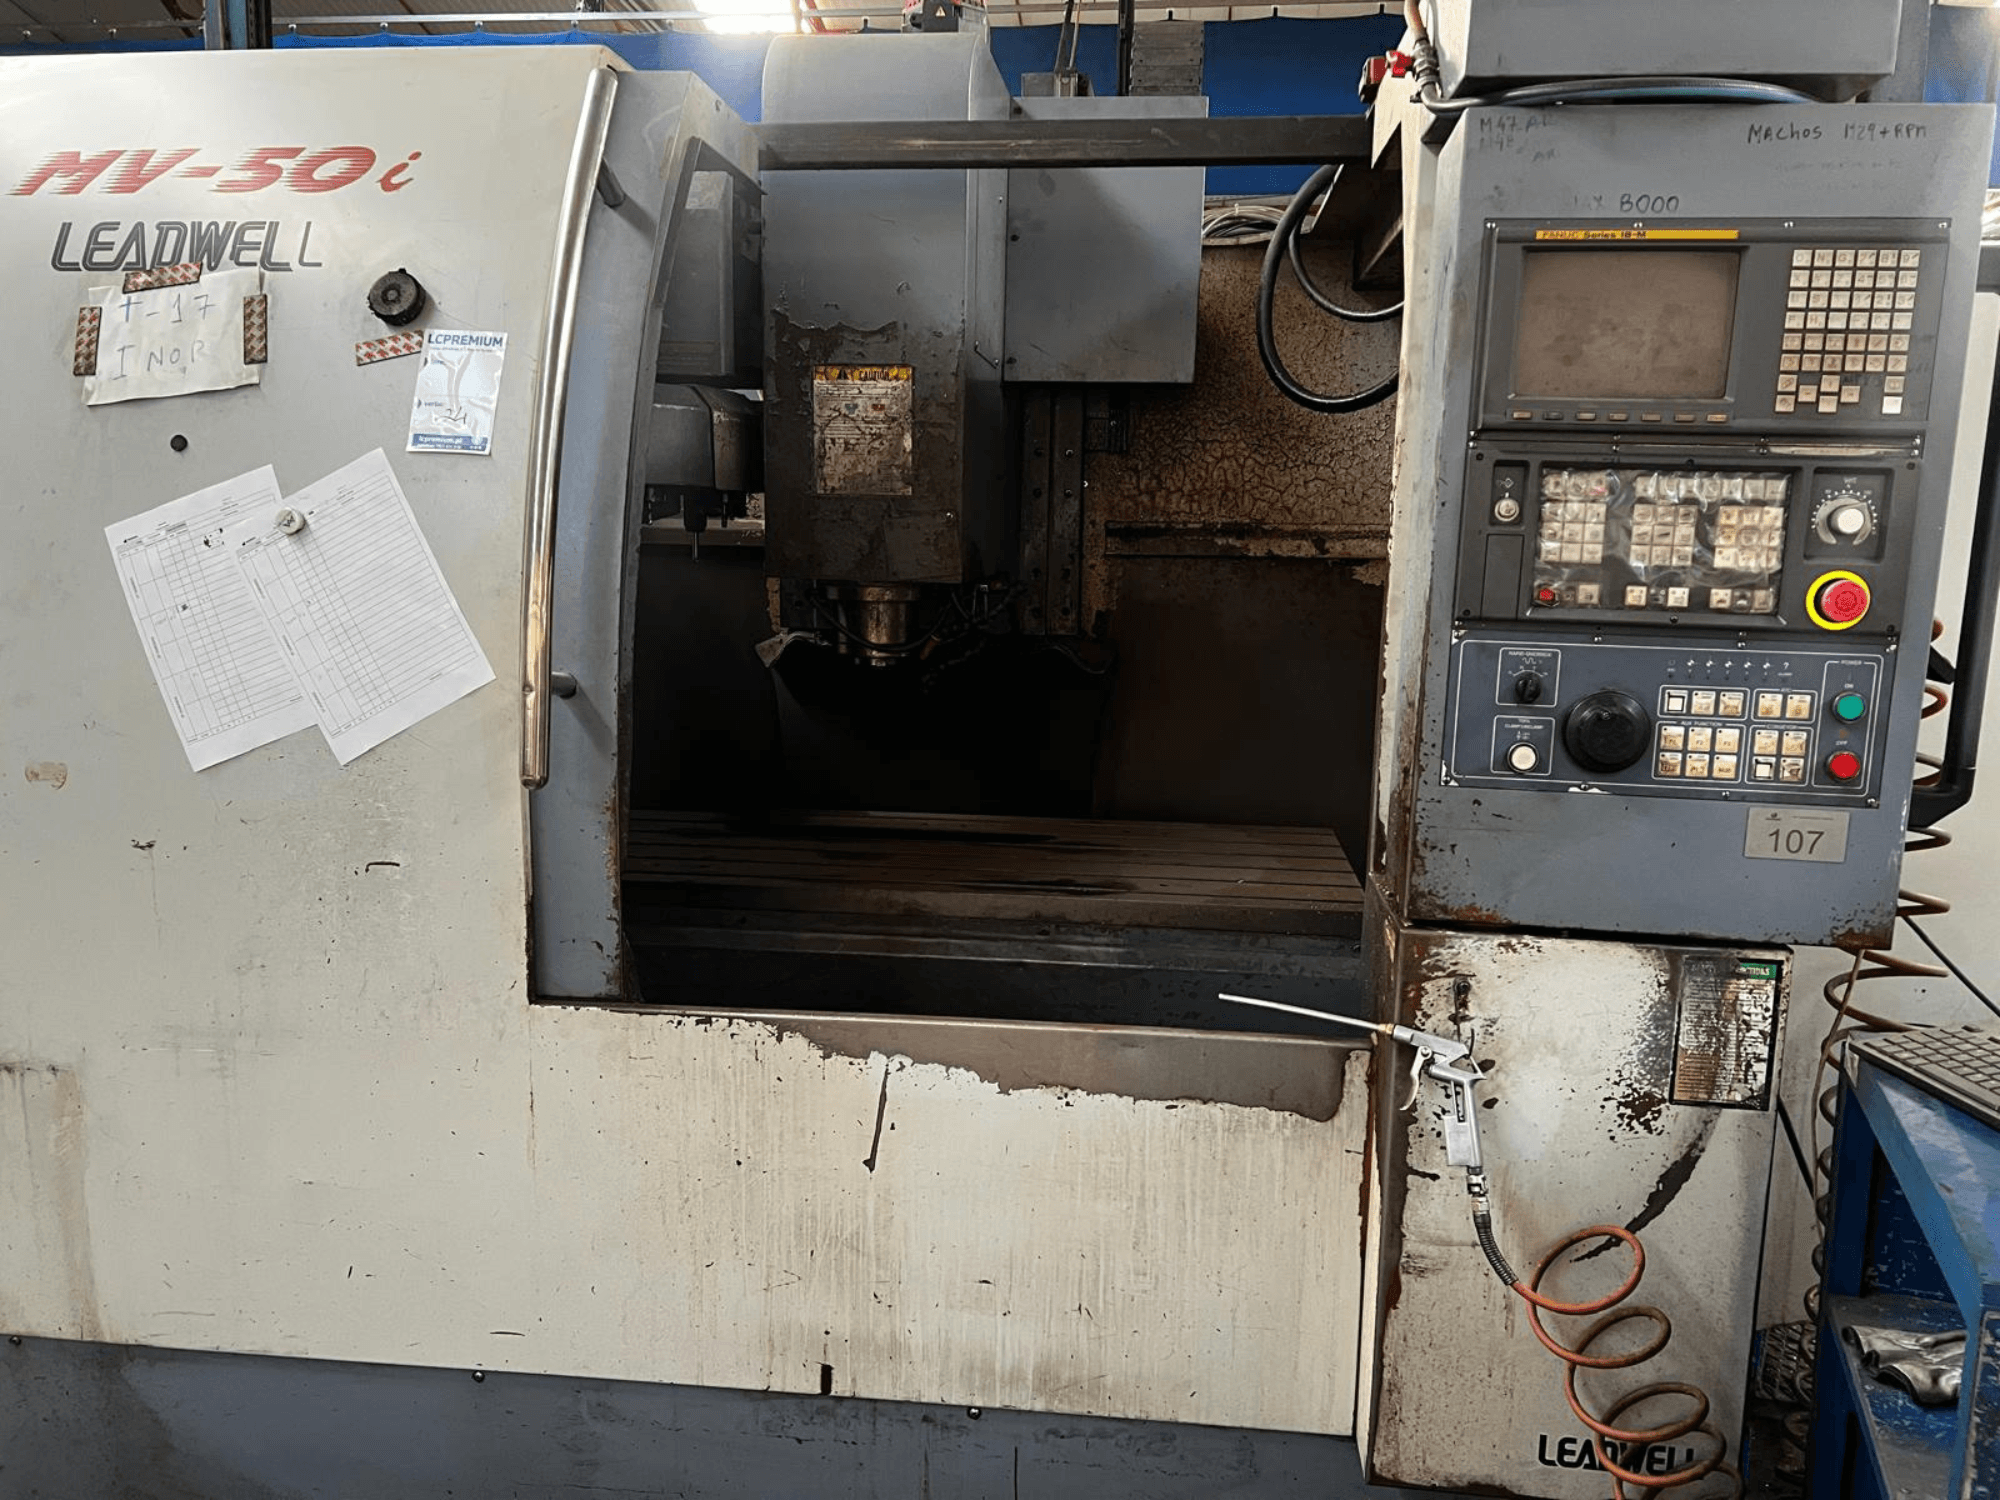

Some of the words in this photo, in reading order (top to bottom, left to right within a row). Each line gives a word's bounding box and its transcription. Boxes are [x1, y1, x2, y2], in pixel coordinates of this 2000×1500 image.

[1584, 230, 1616, 239] Series
[51, 221, 322, 272] LEADWELL
[428, 333, 503, 347] LCPREMIUM
[1769, 828, 1825, 855] 107
